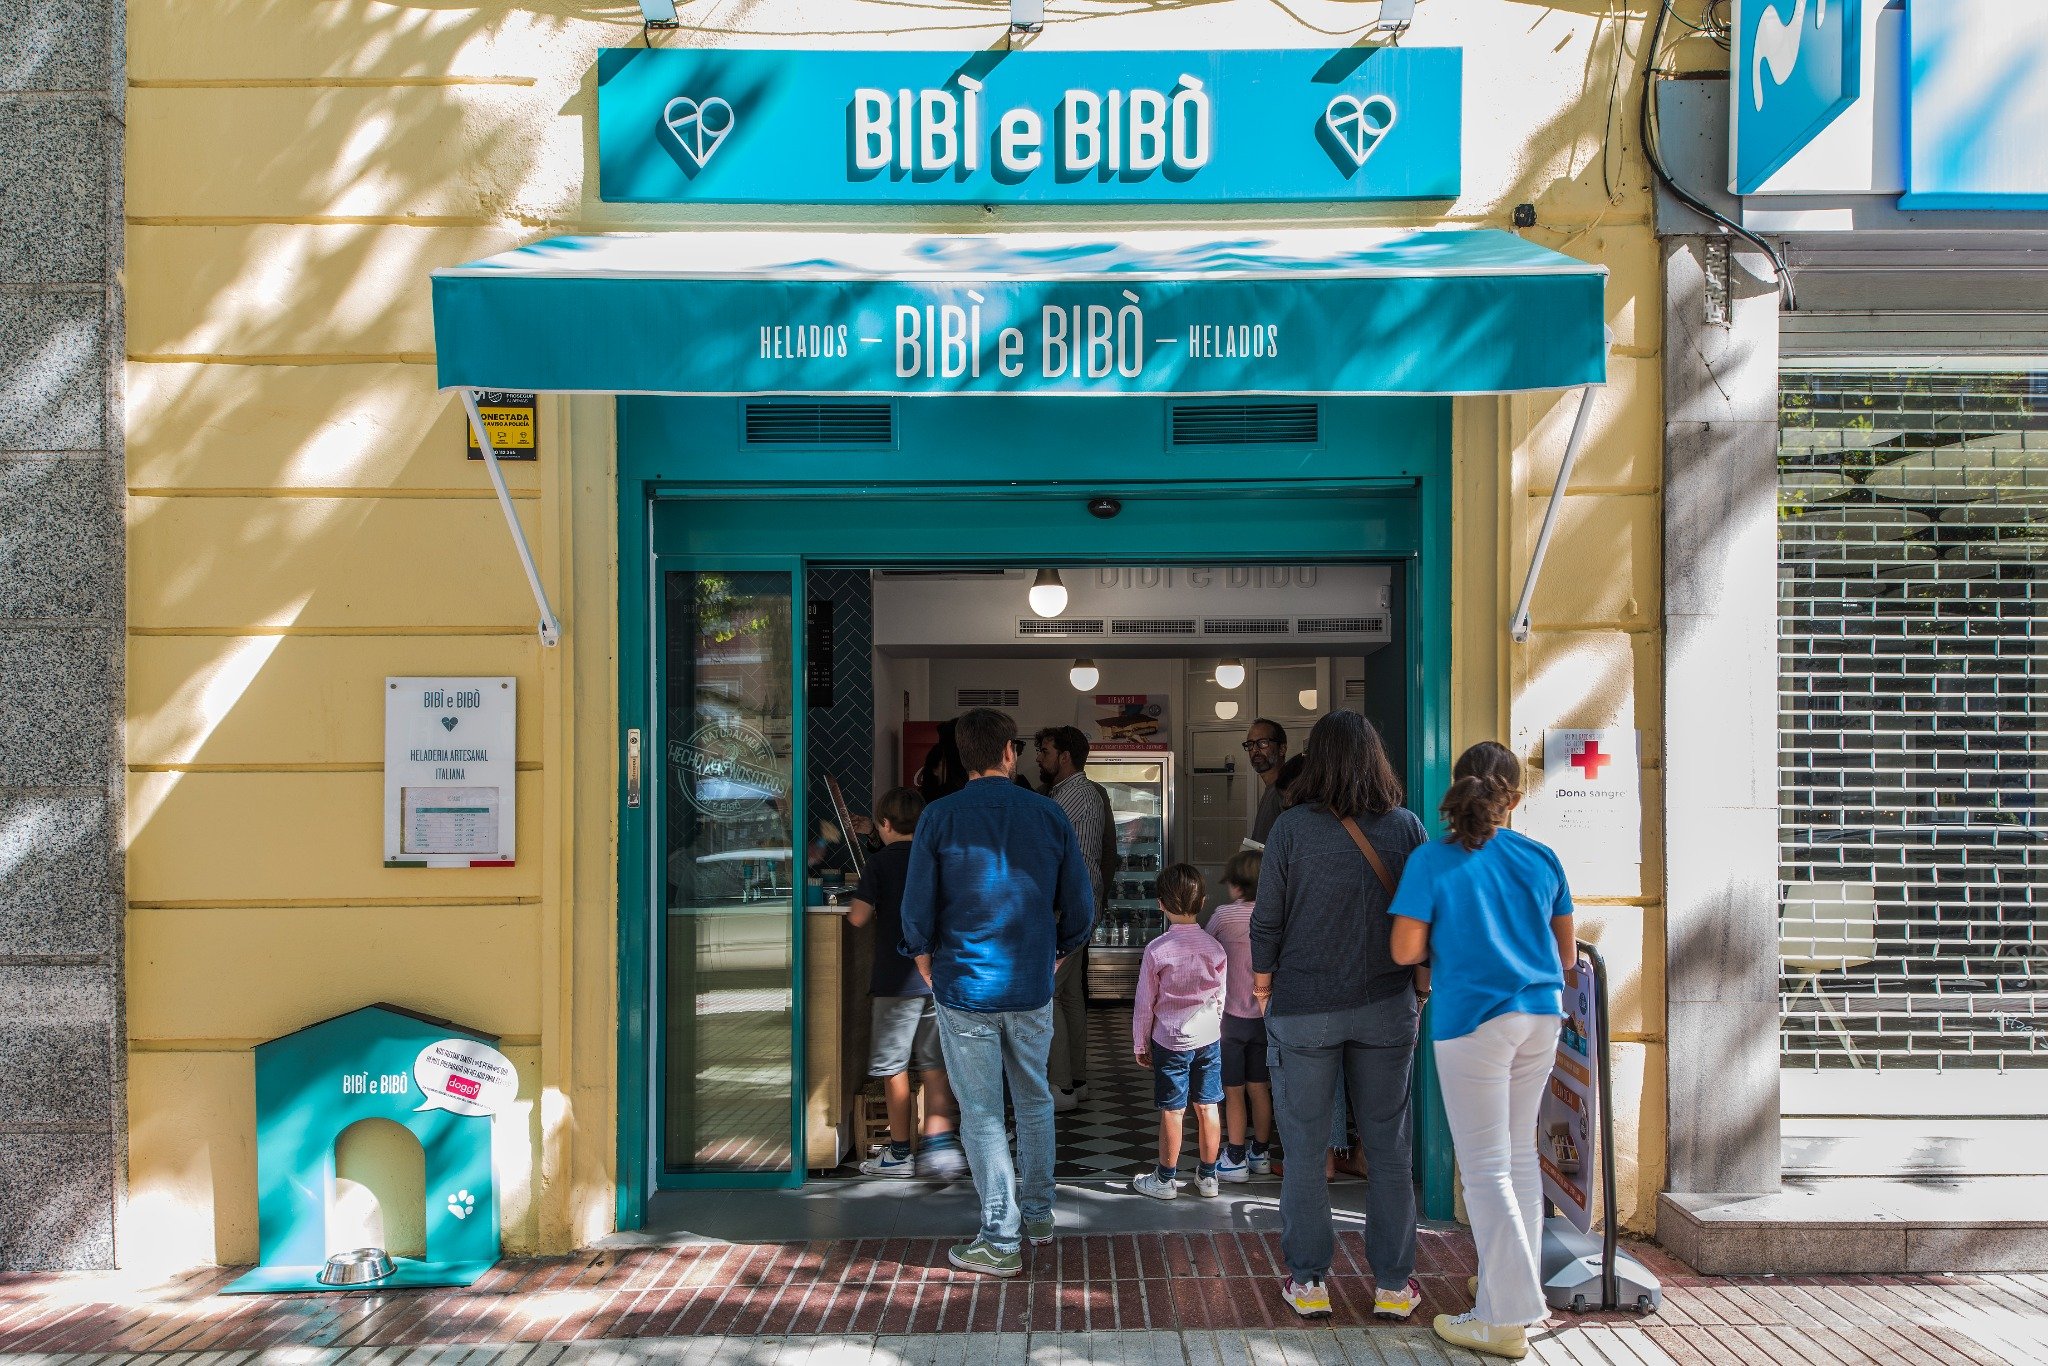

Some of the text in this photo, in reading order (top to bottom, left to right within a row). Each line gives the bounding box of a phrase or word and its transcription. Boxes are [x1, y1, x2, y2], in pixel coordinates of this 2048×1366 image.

[854, 74, 1210, 172] BIBÌ e BIBÒ
[760, 290, 1278, 379] HELADOS BIBÌ e BIBÒ HELADOS
[481, 413, 530, 421] ONECTADA
[424, 688, 480, 708] BIBÌ e BIBÒ
[700, 729, 768, 761] NATURALMENTE
[410, 749, 488, 762] HELADERIA ARTESANAL
[435, 768, 466, 780] ITALIANA
[668, 744, 704, 770] HECHO
[732, 763, 784, 794] NOSOTROS
[1556, 789, 1628, 800] ¡Dona sangre
[343, 1072, 368, 1094] BIBÌ
[370, 1080, 378, 1094] e
[380, 1072, 408, 1094] BIBÒ
[448, 1078, 480, 1096] doggy
